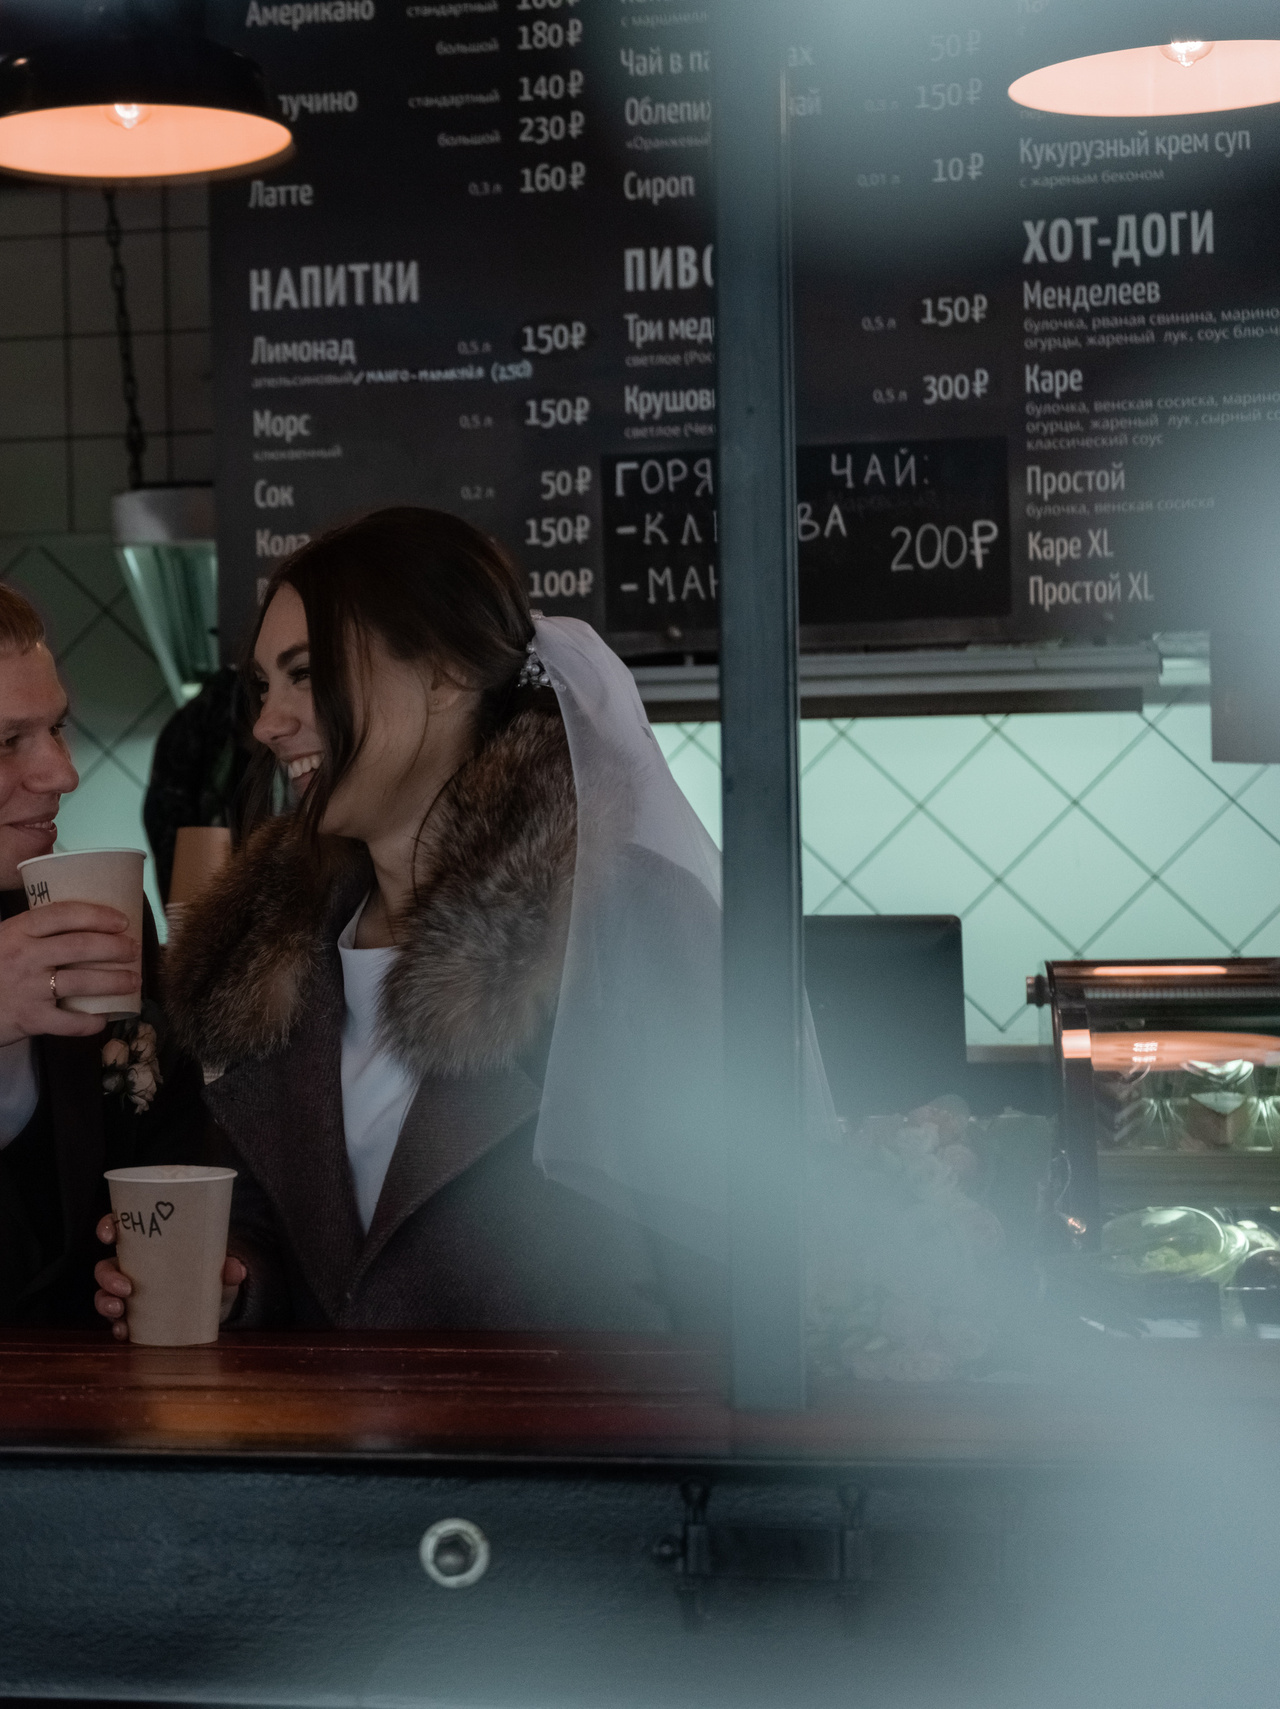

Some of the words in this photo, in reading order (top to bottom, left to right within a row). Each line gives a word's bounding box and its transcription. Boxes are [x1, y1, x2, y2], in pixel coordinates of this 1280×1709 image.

[245, 0, 376, 32] Американо
[620, 45, 664, 77] Чай
[669, 51, 684, 75] в
[1020, 129, 1150, 171] Кукурузный
[1154, 132, 1210, 162] крем
[1214, 129, 1252, 160] суп
[248, 179, 315, 210] Латте
[623, 170, 696, 207] Сироп
[1021, 208, 1216, 269] ХОТ-ДОГИ
[249, 259, 420, 312] НАПИТКИ
[1023, 279, 1161, 314] Менделеев
[623, 312, 664, 350] Три
[667, 316, 716, 345] мед
[1197, 326, 1231, 345] соус
[251, 335, 358, 366] Лимонад
[1025, 361, 1085, 401] Каре
[623, 384, 716, 421] Крушов
[253, 408, 312, 444] Морс
[615, 456, 715, 498] ГОРЯ
[829, 446, 930, 490] ЧАЙ:
[1026, 460, 1126, 502] Простой
[254, 478, 295, 510] Сок
[1028, 530, 1083, 568] Каре
[1086, 526, 1114, 559] XL
[1029, 571, 1123, 613] Простой
[1126, 569, 1156, 603] XL
